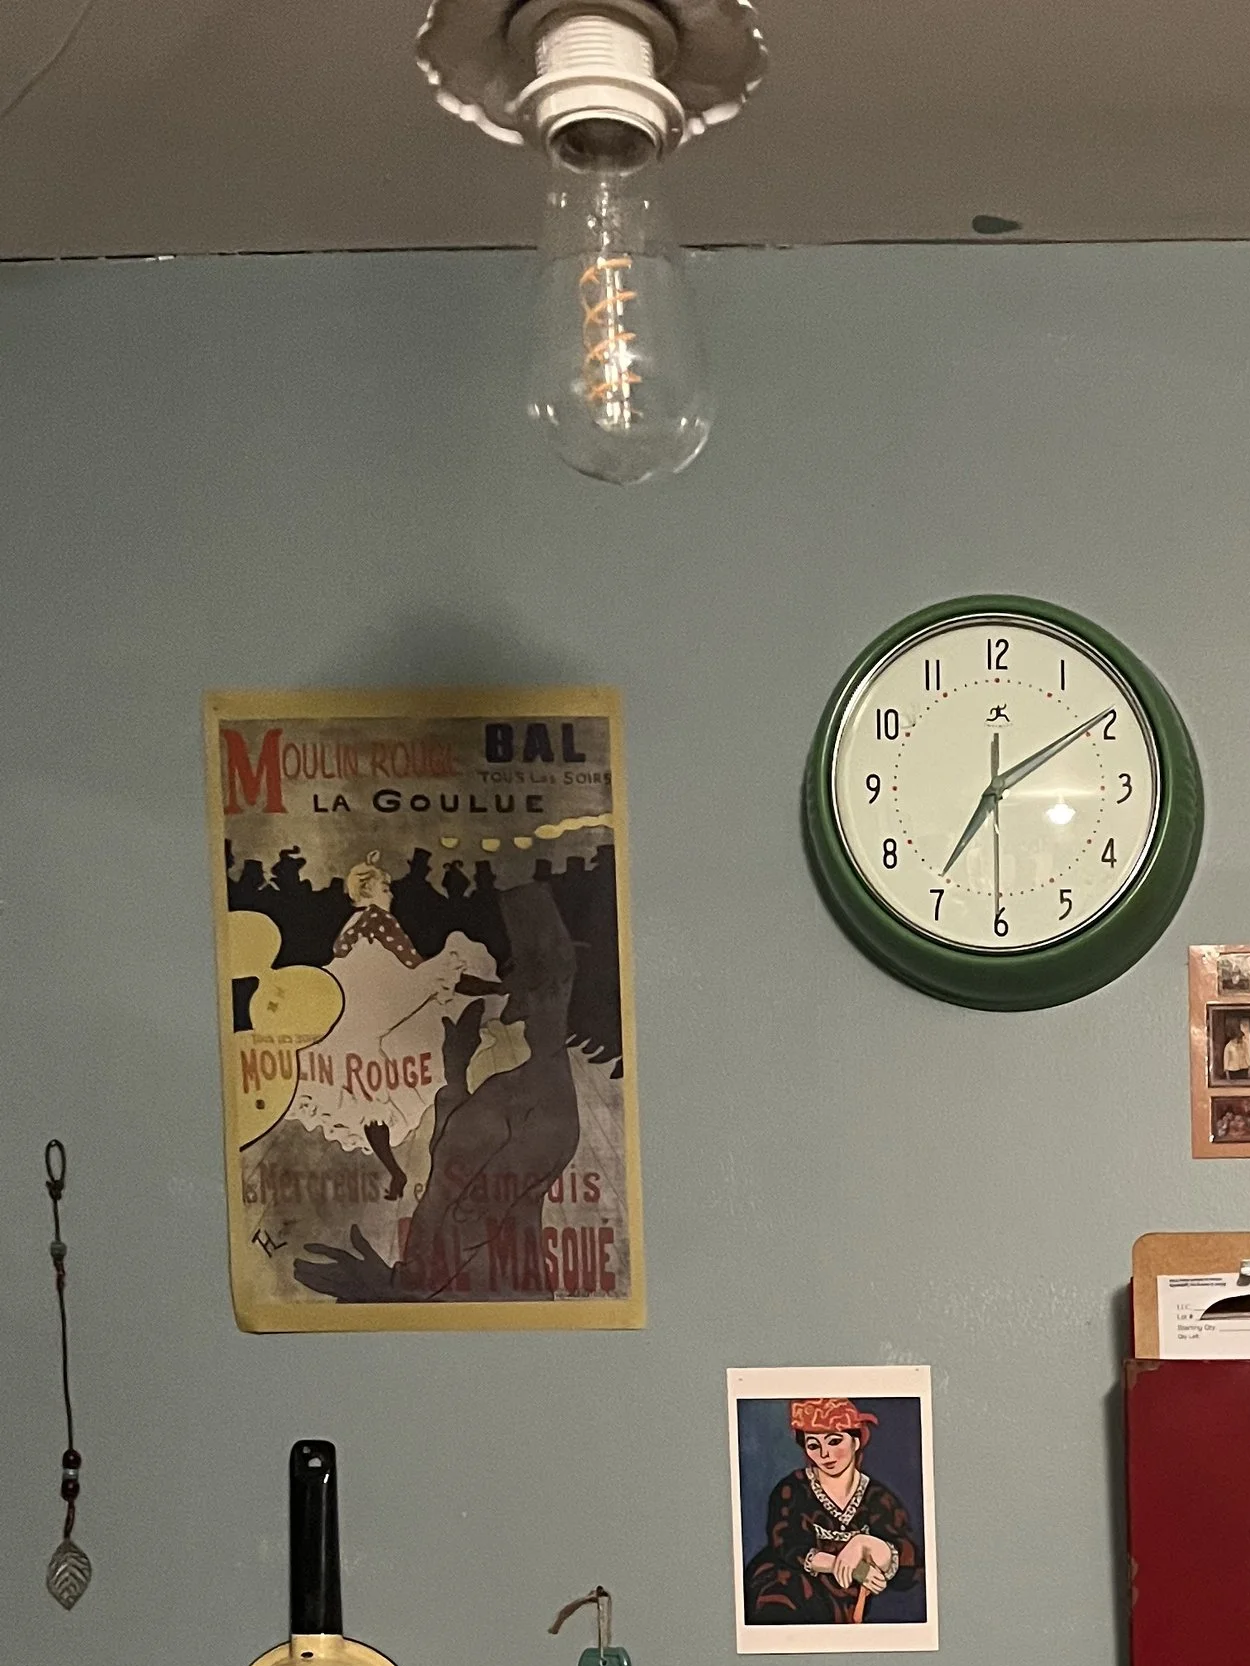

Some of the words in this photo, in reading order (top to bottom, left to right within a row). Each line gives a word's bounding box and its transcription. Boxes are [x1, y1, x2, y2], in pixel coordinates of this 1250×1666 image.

[986, 638, 1010, 670] 12
[924, 659, 941, 691] 11
[1059, 659, 1066, 691] 1
[875, 708, 900, 740] 10
[1102, 709, 1117, 740] 2
[485, 723, 586, 763] BAL
[478, 771, 525, 784] TOUS
[865, 773, 881, 804] 9
[1116, 773, 1133, 804] 3
[313, 794, 350, 812] LA
[372, 789, 544, 813] GOULUE
[882, 838, 898, 869] 8
[1100, 837, 1118, 868] 4
[929, 889, 945, 921] 7
[1058, 889, 1073, 921] 5
[993, 907, 1009, 937] 6
[240, 1048, 334, 1094] MOULIN
[342, 1051, 433, 1102] ROUGE
